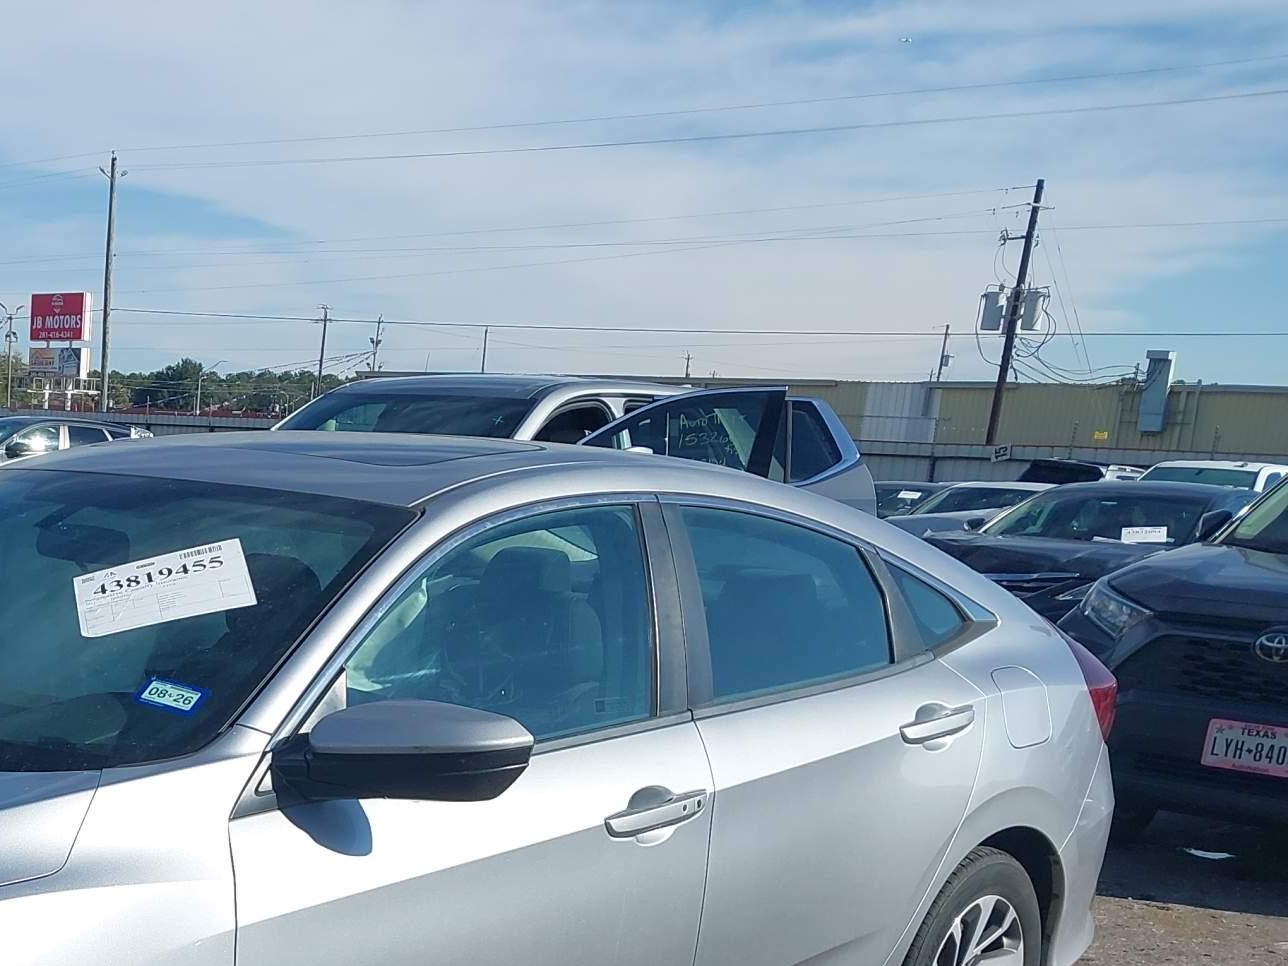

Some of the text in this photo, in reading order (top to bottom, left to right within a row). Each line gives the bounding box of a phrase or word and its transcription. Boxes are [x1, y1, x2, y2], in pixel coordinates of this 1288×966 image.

[32, 315, 81, 329] JB MOTORS
[93, 555, 224, 596] 43819455
[1240, 727, 1277, 740] TEXAS
